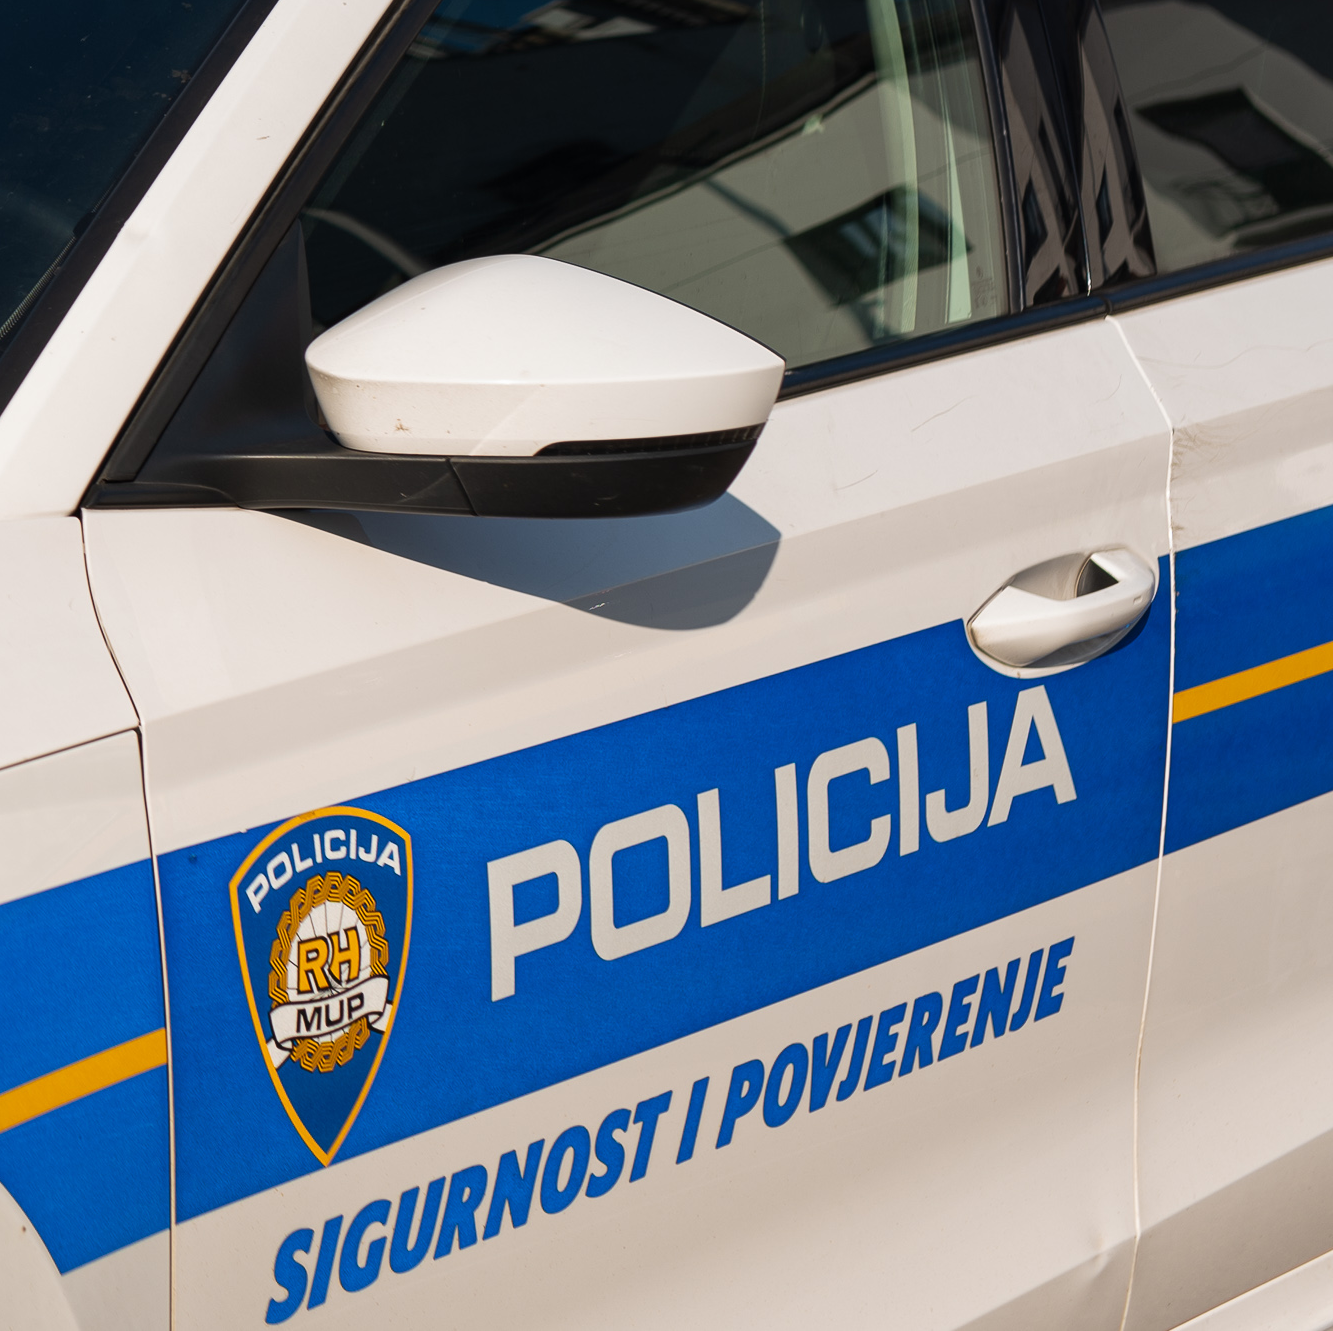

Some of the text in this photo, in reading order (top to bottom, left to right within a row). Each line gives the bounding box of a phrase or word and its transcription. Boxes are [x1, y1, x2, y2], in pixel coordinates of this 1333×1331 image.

[245, 828, 402, 914] POLICIJA
[486, 684, 1078, 1003] POLICIJA
[297, 925, 361, 996] RH
[295, 991, 366, 1036] MUP
[264, 936, 1076, 1326] SIGURNOST I POVJERENJE
